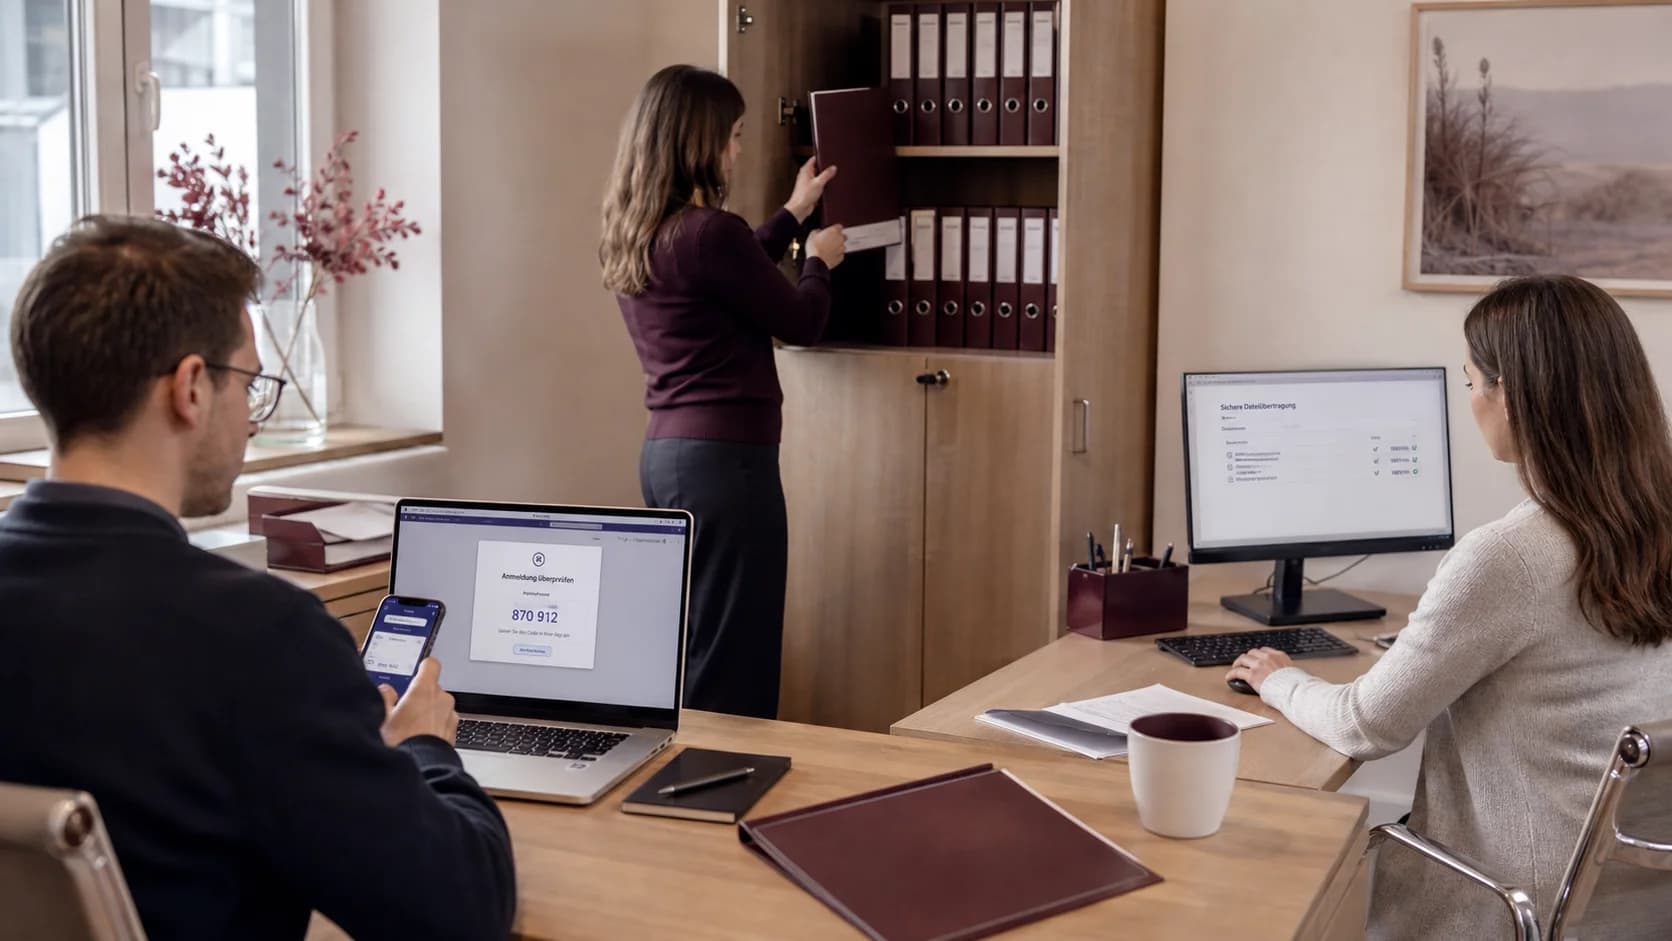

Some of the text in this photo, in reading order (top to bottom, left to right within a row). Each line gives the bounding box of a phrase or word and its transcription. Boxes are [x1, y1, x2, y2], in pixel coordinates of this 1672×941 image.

[1220, 403, 1243, 411] Sichere
[502, 573, 537, 583] Anmeldung
[512, 609, 558, 624] 870 912
